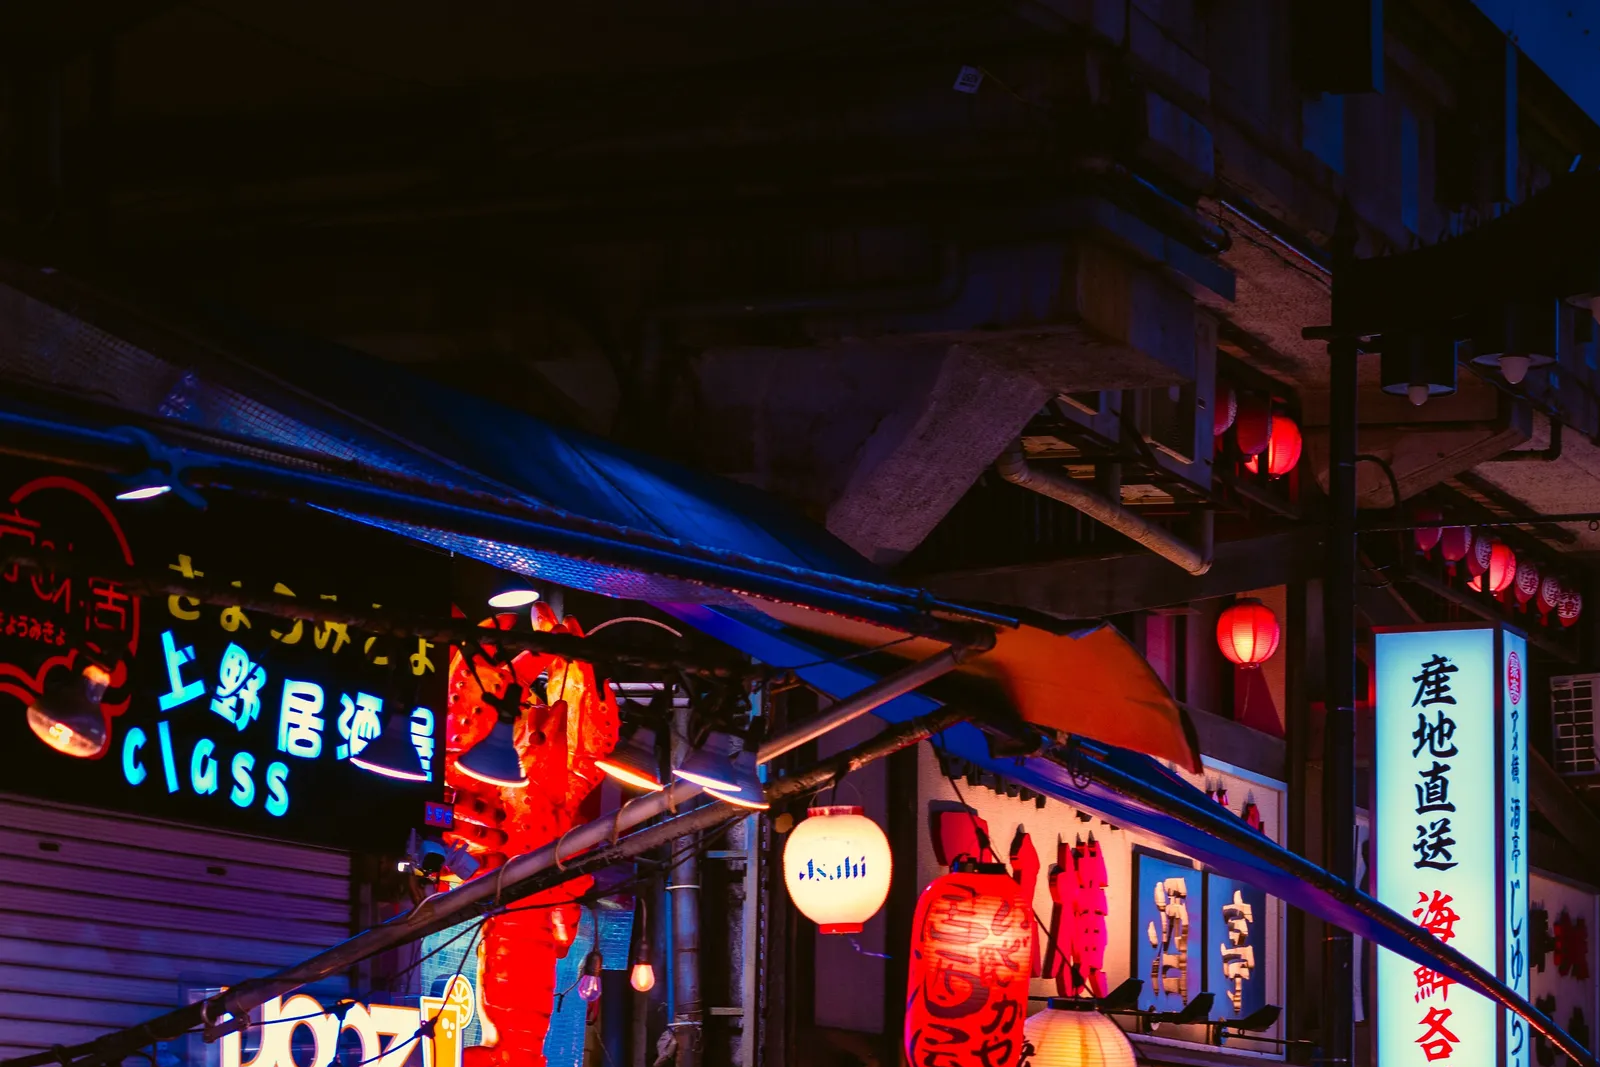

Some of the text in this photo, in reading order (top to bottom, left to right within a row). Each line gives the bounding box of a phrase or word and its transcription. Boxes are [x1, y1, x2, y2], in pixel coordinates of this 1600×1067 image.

[122, 720, 290, 817] class
[1411, 653, 1460, 872] 産地直送
